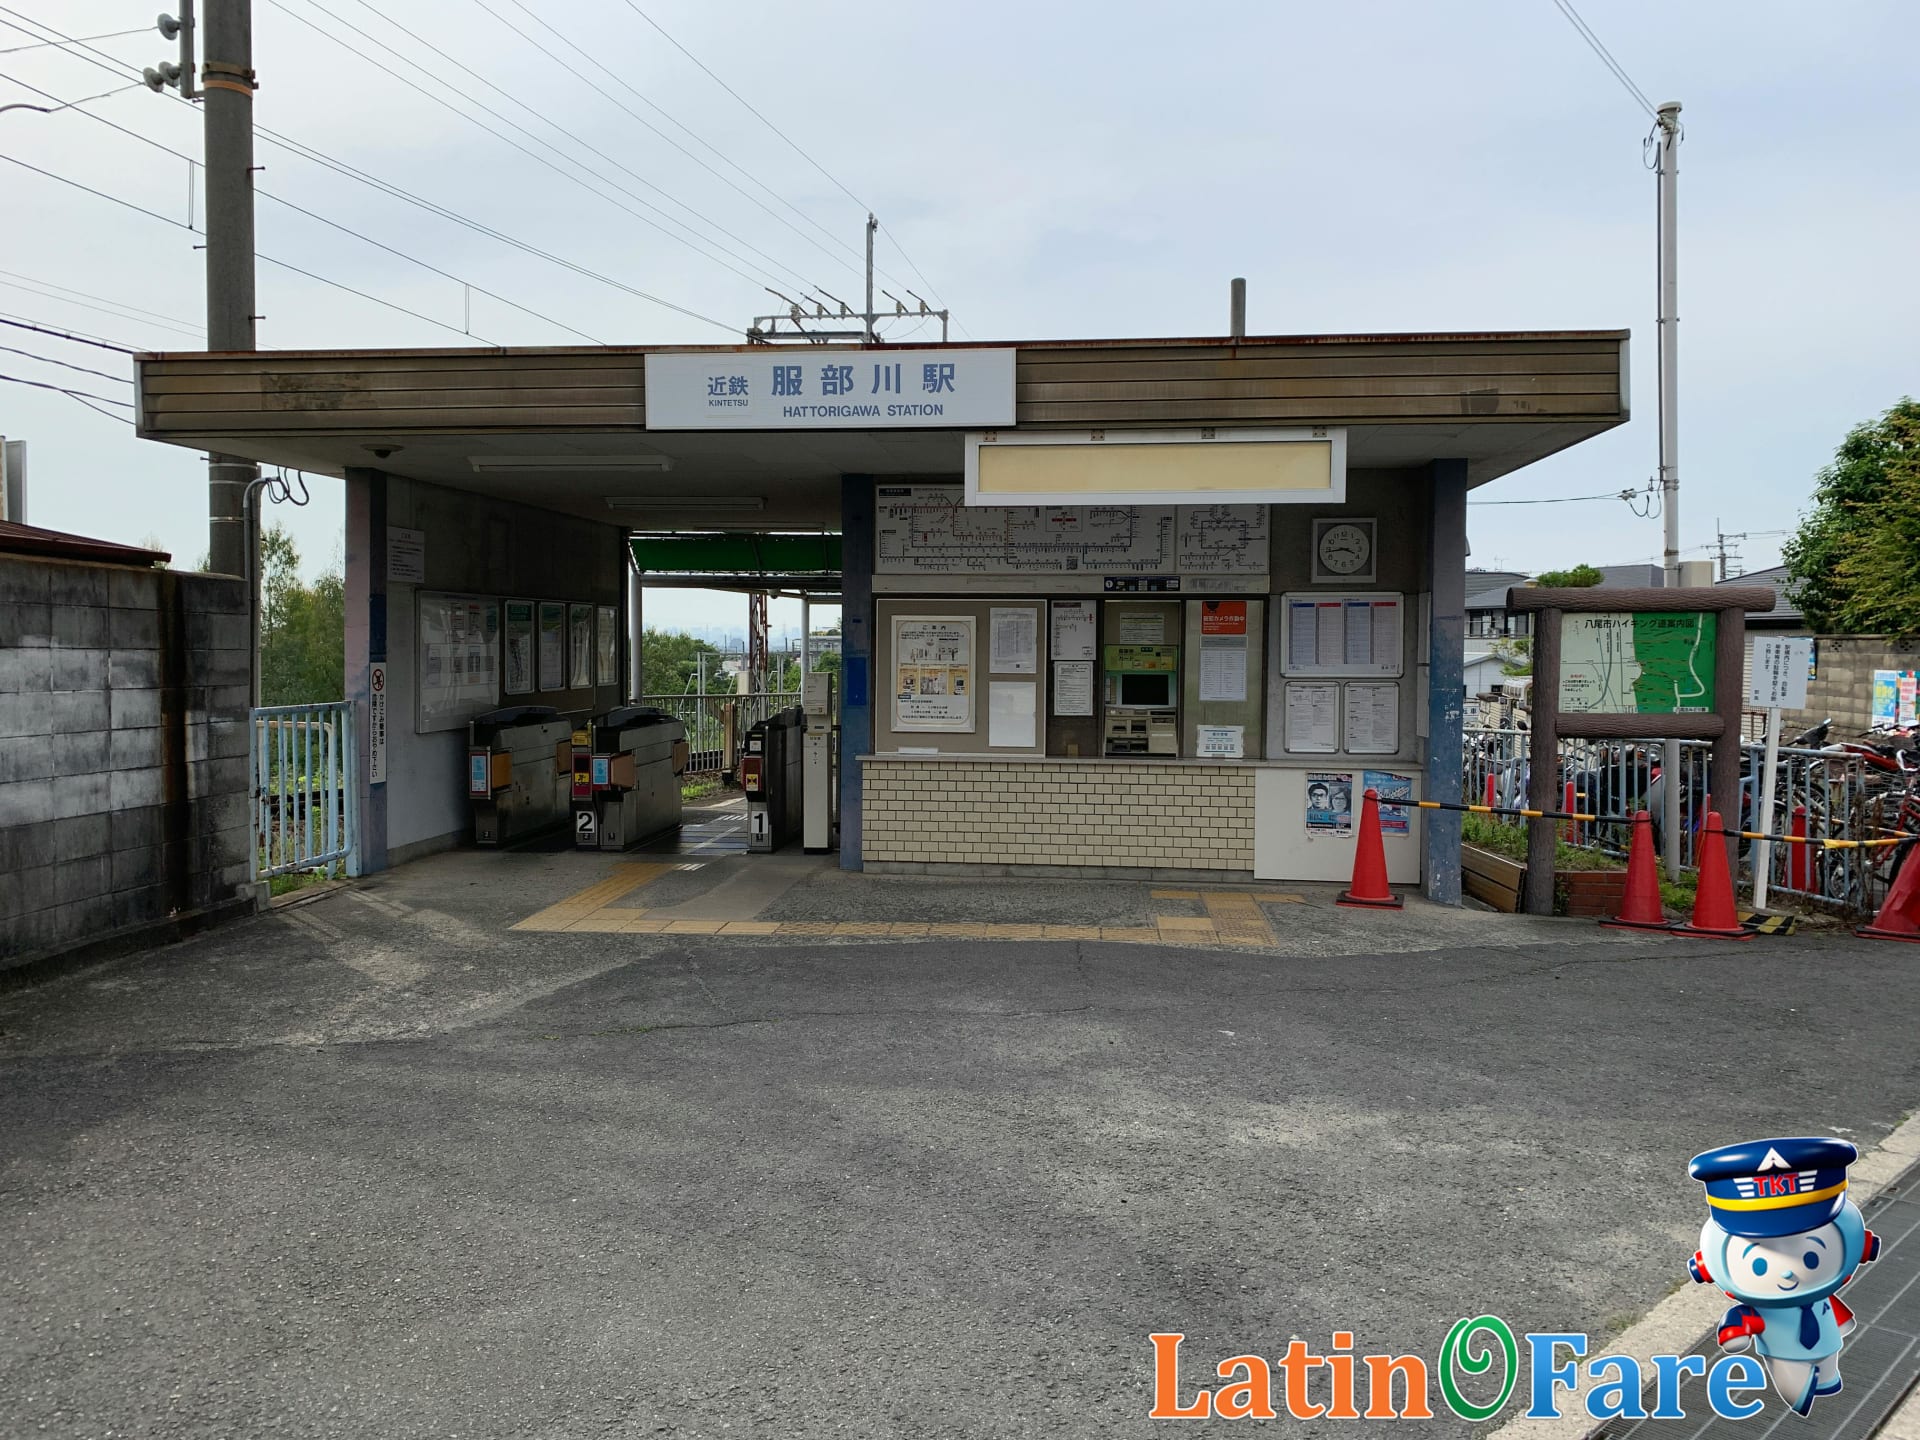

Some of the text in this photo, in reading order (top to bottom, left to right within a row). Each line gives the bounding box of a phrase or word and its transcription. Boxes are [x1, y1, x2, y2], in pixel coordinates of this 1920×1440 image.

[707, 375, 749, 397] 近鉄
[771, 363, 956, 396] 服部川駅
[708, 399, 749, 407] KINTETSU
[783, 404, 944, 418] HATTORIGAWA STATION
[1585, 618, 1695, 629] 八尾市ハイキング道案内図
[578, 812, 593, 833] 2
[754, 813, 764, 833] 1
